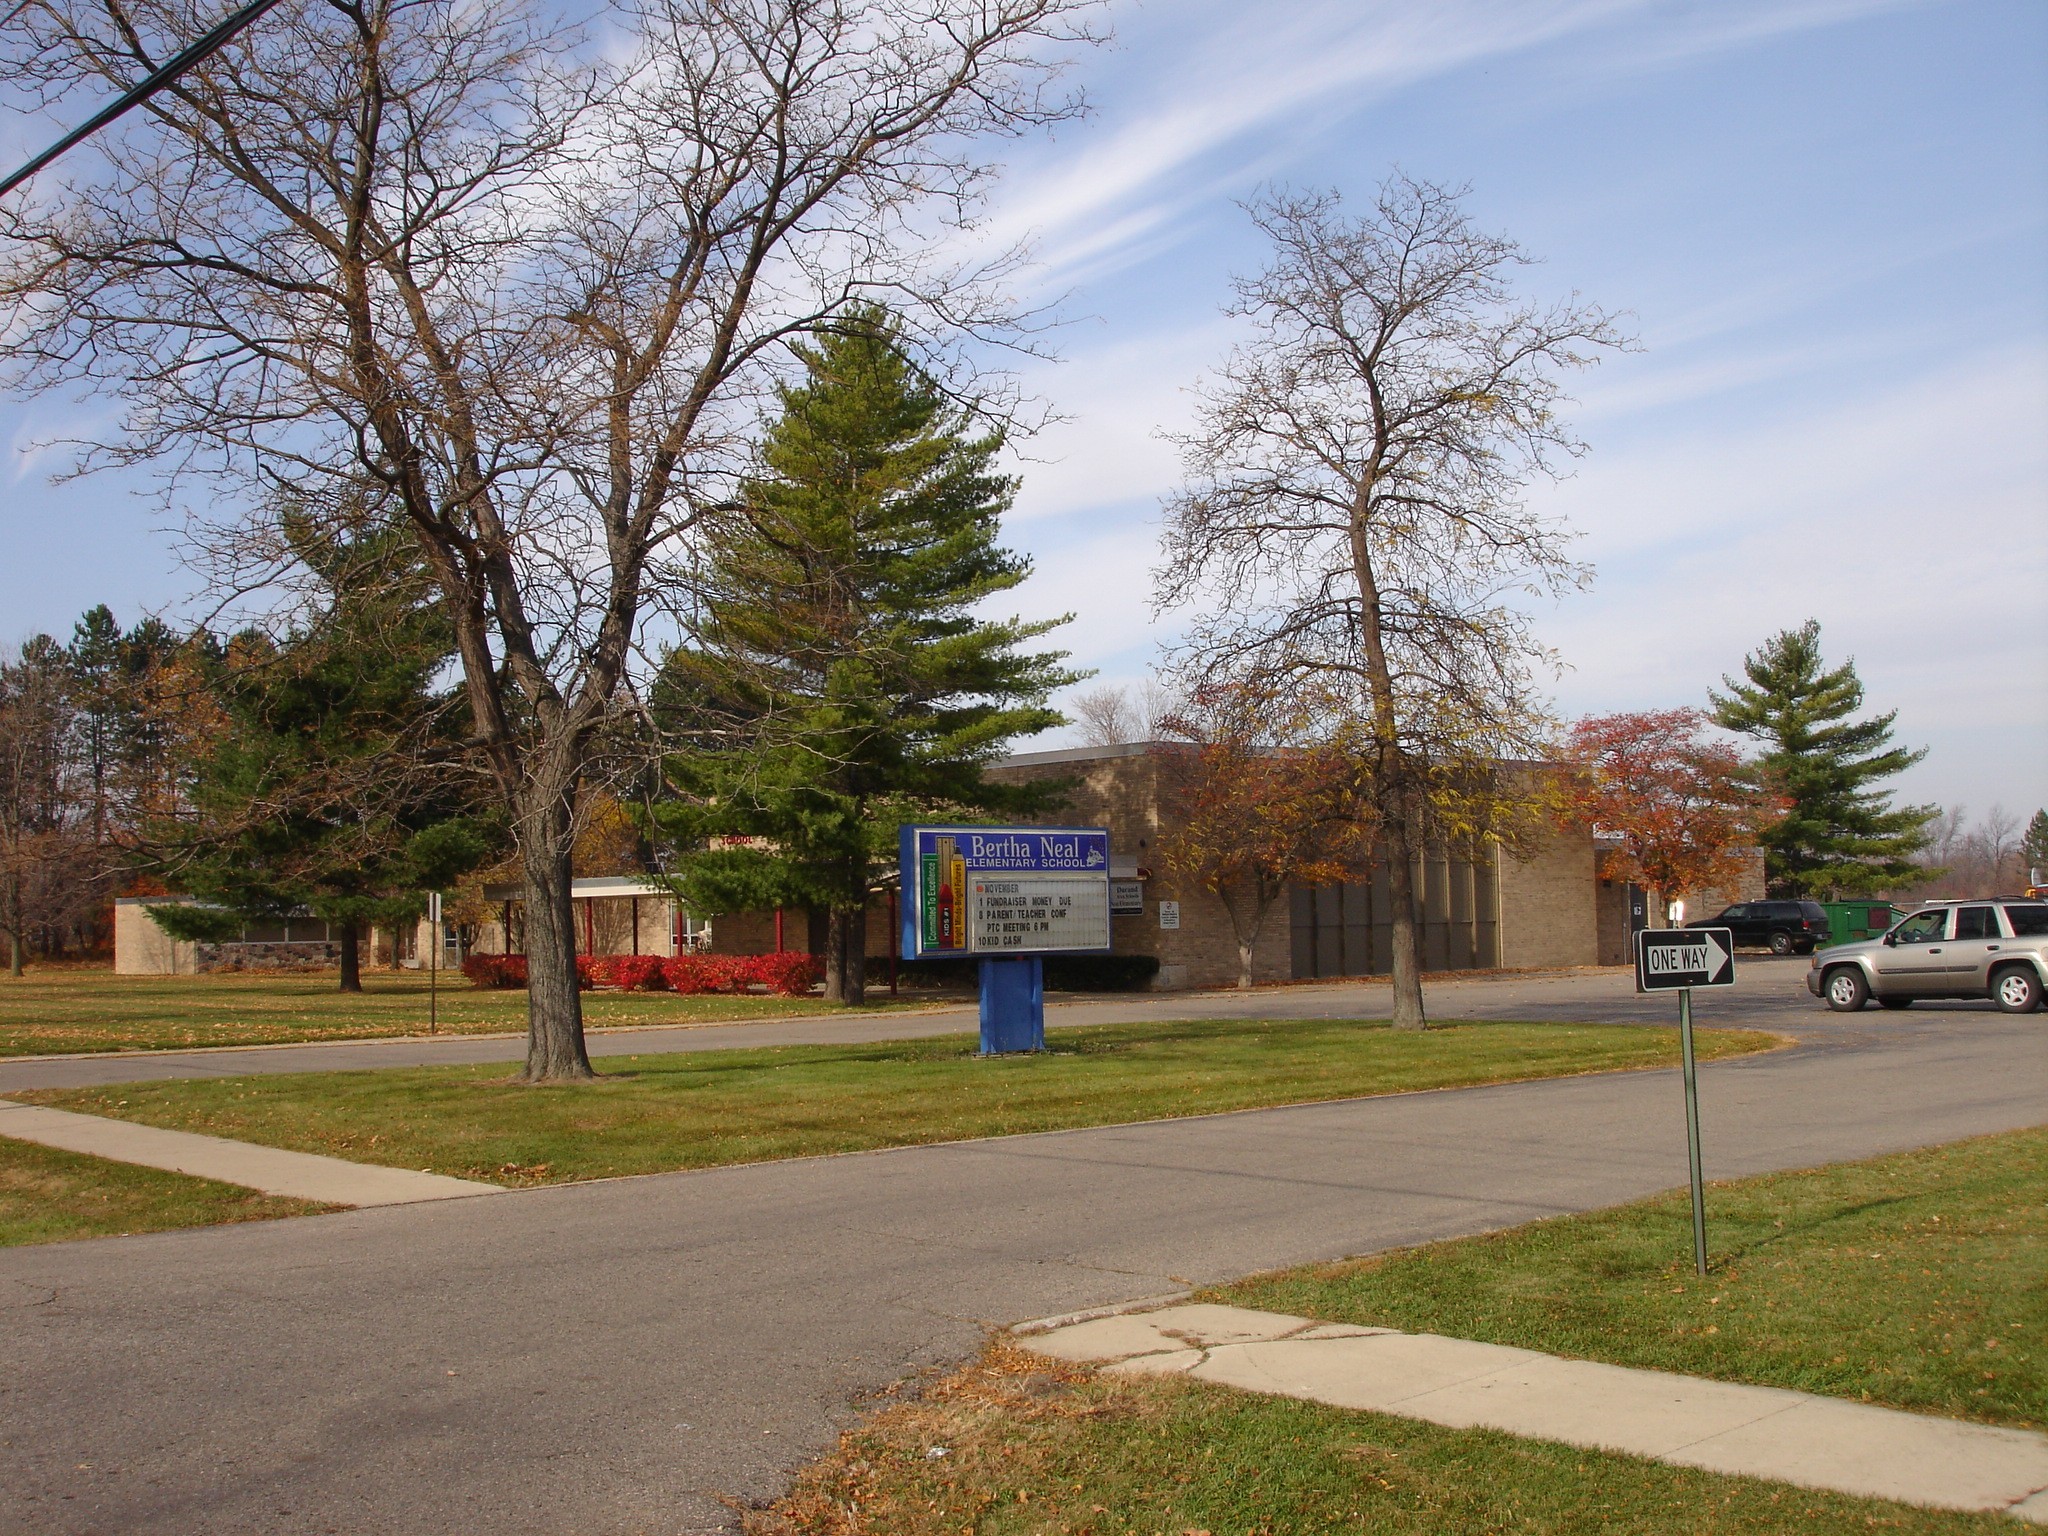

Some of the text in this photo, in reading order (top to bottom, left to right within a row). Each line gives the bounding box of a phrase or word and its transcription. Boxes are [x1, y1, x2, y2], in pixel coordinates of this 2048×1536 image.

[972, 835, 1079, 858] Bertha Neal
[965, 858, 1086, 868] ELEMENTARY SCHOOL
[954, 863, 962, 887] Futures
[985, 884, 1019, 893] NOVEMBER
[927, 862, 937, 941] Committed To Excellence
[979, 896, 1071, 907] 1 FUNDRAISER MONEY DUE
[1050, 909, 1067, 918] CONF
[986, 923, 1000, 932] PTC
[1003, 922, 1031, 932] MEETING
[1040, 922, 1049, 931] PM
[954, 927, 963, 945] Bright
[1003, 936, 1022, 945] CASH
[1651, 947, 1708, 970] ONE WAY
